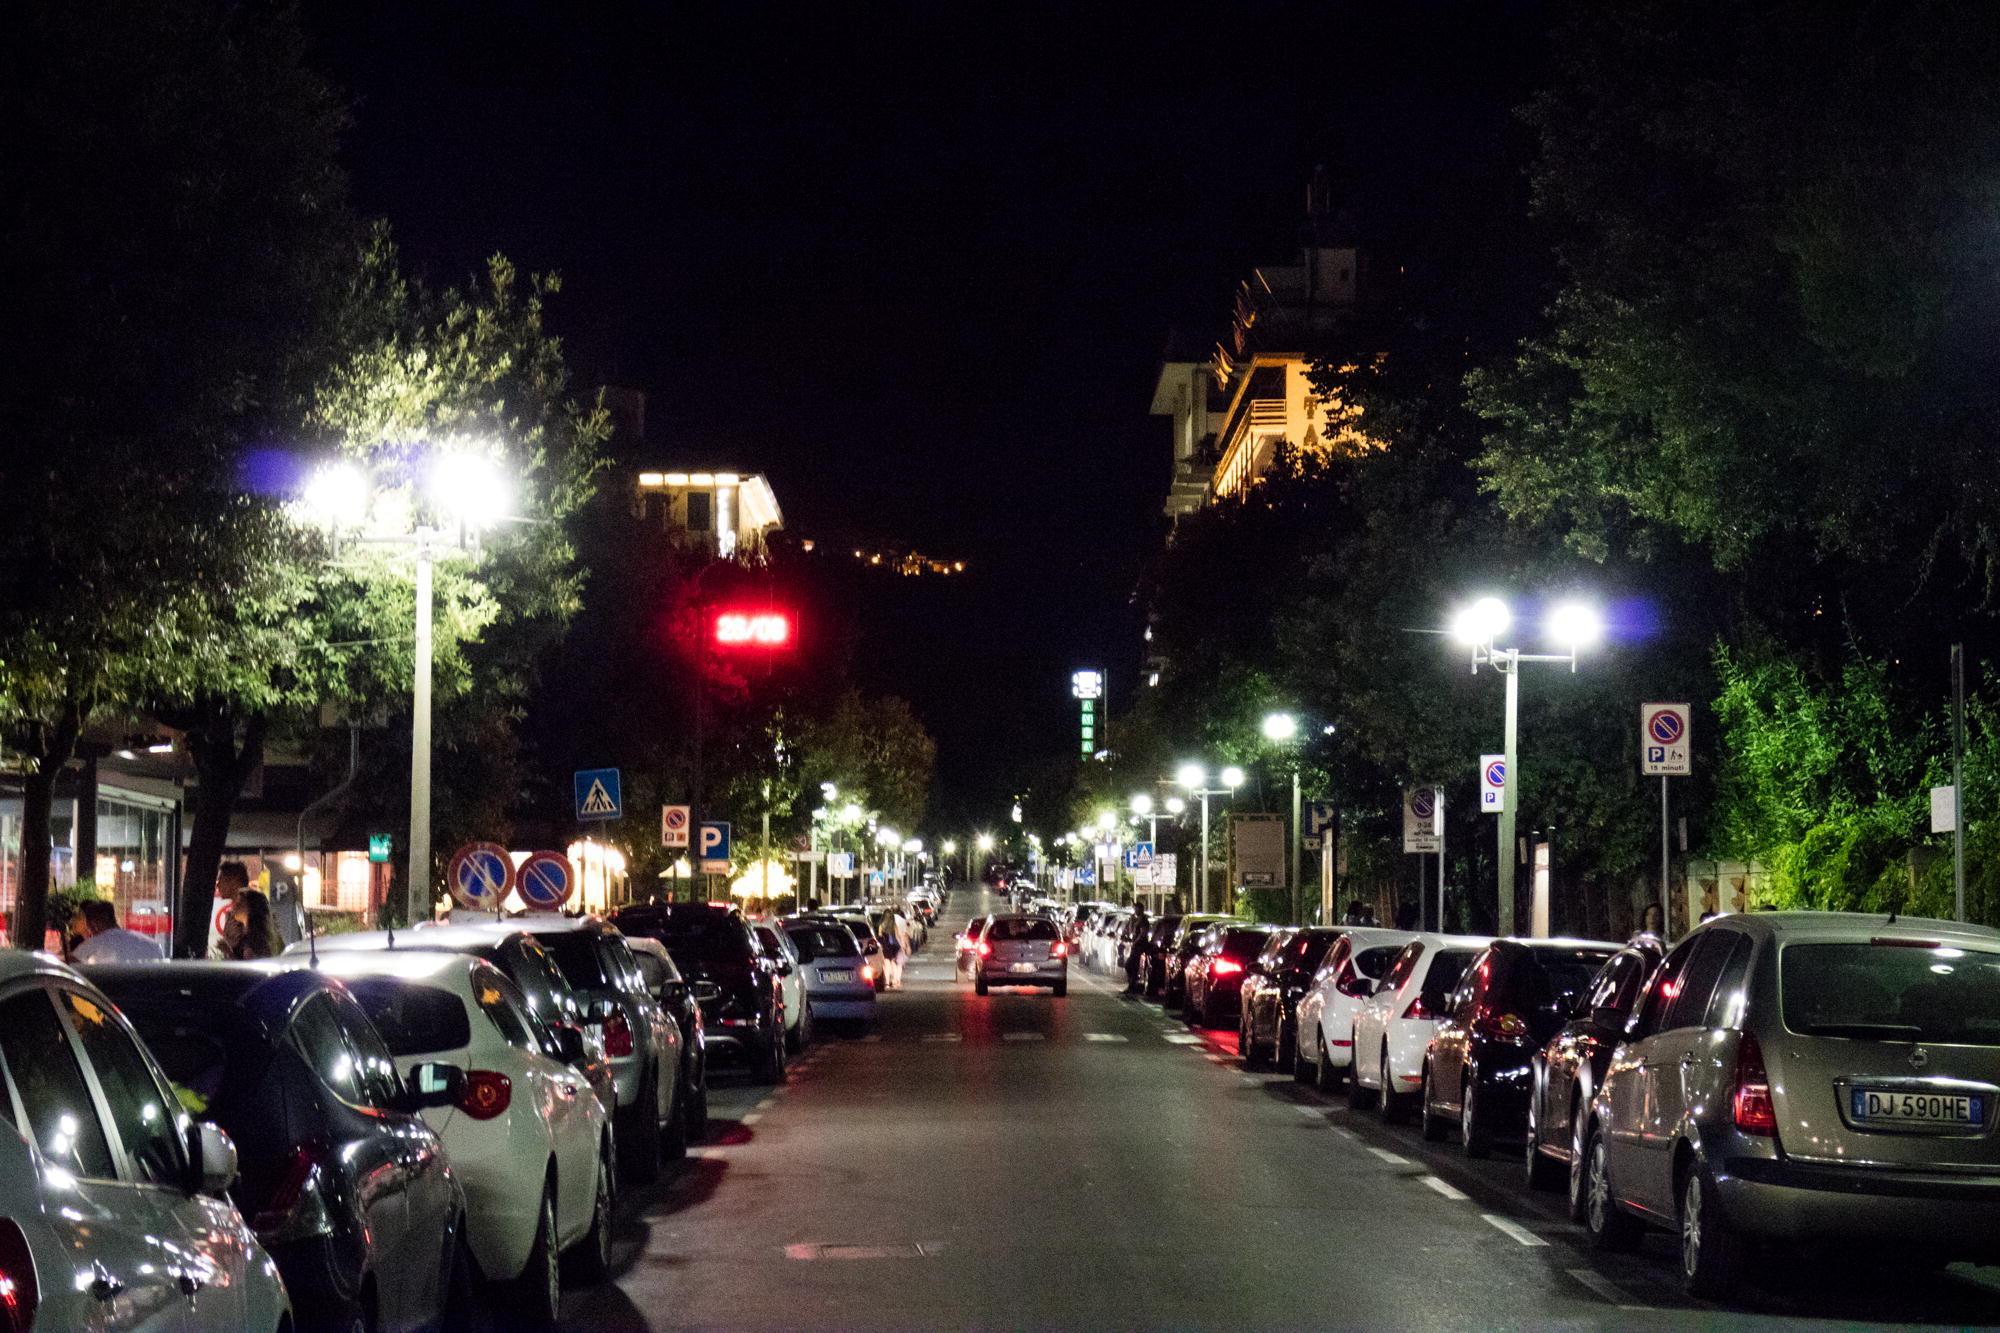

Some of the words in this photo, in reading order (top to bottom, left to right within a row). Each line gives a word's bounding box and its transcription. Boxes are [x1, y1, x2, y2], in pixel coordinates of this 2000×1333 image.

[1652, 749, 1661, 760] P
[1312, 803, 1334, 834] P
[700, 827, 722, 856] P
[276, 881, 288, 900] P
[1869, 1094, 1894, 1116] DJ
[1902, 1096, 1969, 1120] 590HE
